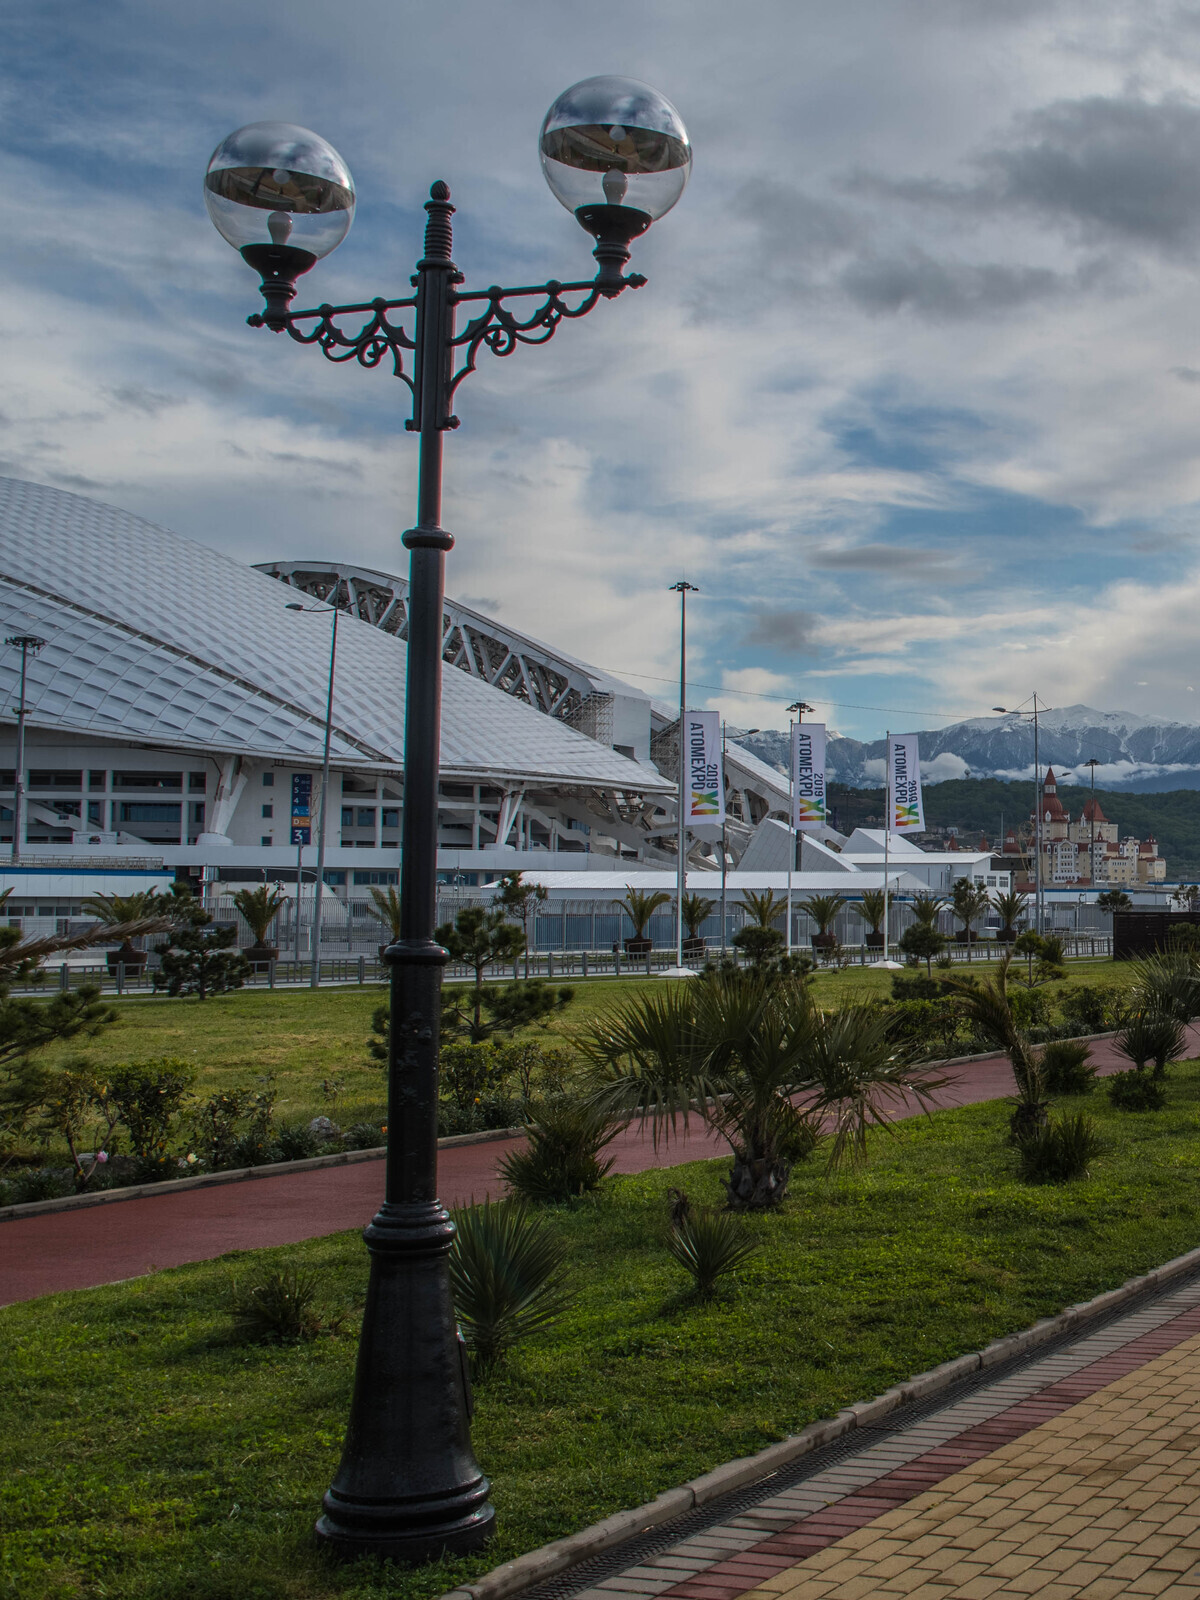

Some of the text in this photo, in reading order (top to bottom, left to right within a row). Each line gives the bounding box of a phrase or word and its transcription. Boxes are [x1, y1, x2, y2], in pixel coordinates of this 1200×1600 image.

[690, 722, 706, 790] ATOMEXPO
[706, 763, 719, 789] 2019
[799, 733, 813, 797] ATOMEXPO
[894, 743, 908, 804] ATOMEXPO
[814, 773, 823, 798] 2019
[294, 829, 303, 842] 3
